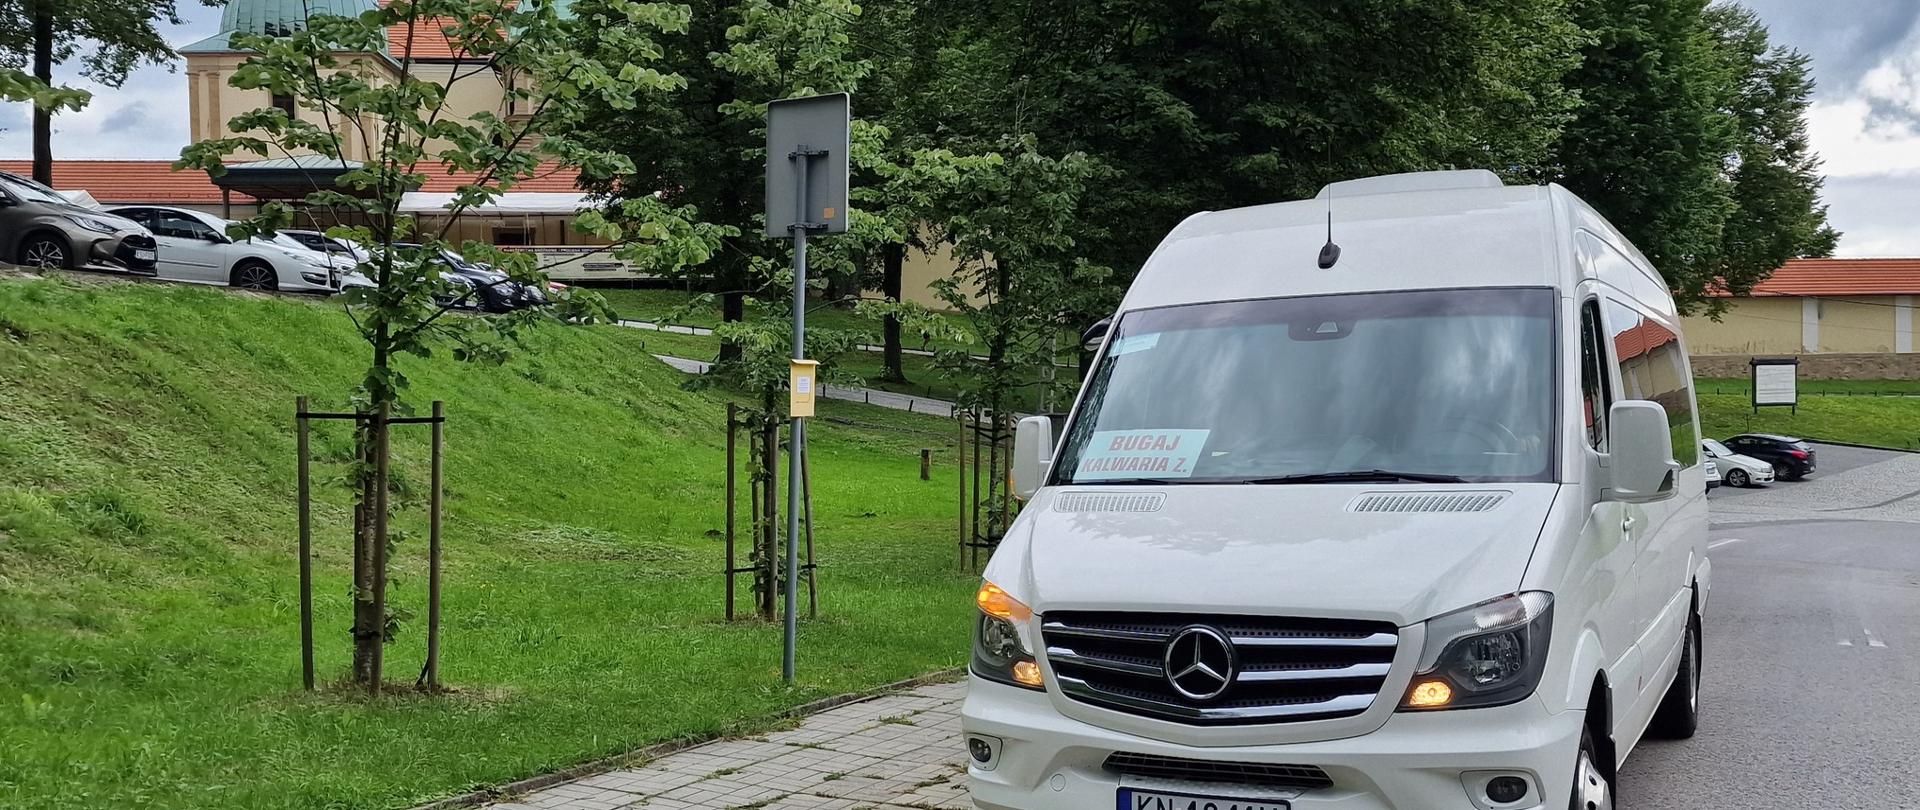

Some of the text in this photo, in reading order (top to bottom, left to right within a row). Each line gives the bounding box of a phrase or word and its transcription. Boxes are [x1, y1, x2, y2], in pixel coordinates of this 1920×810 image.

[1109, 435, 1180, 451] BUGAJ
[1082, 457, 1187, 472] KALWARIA Z.
